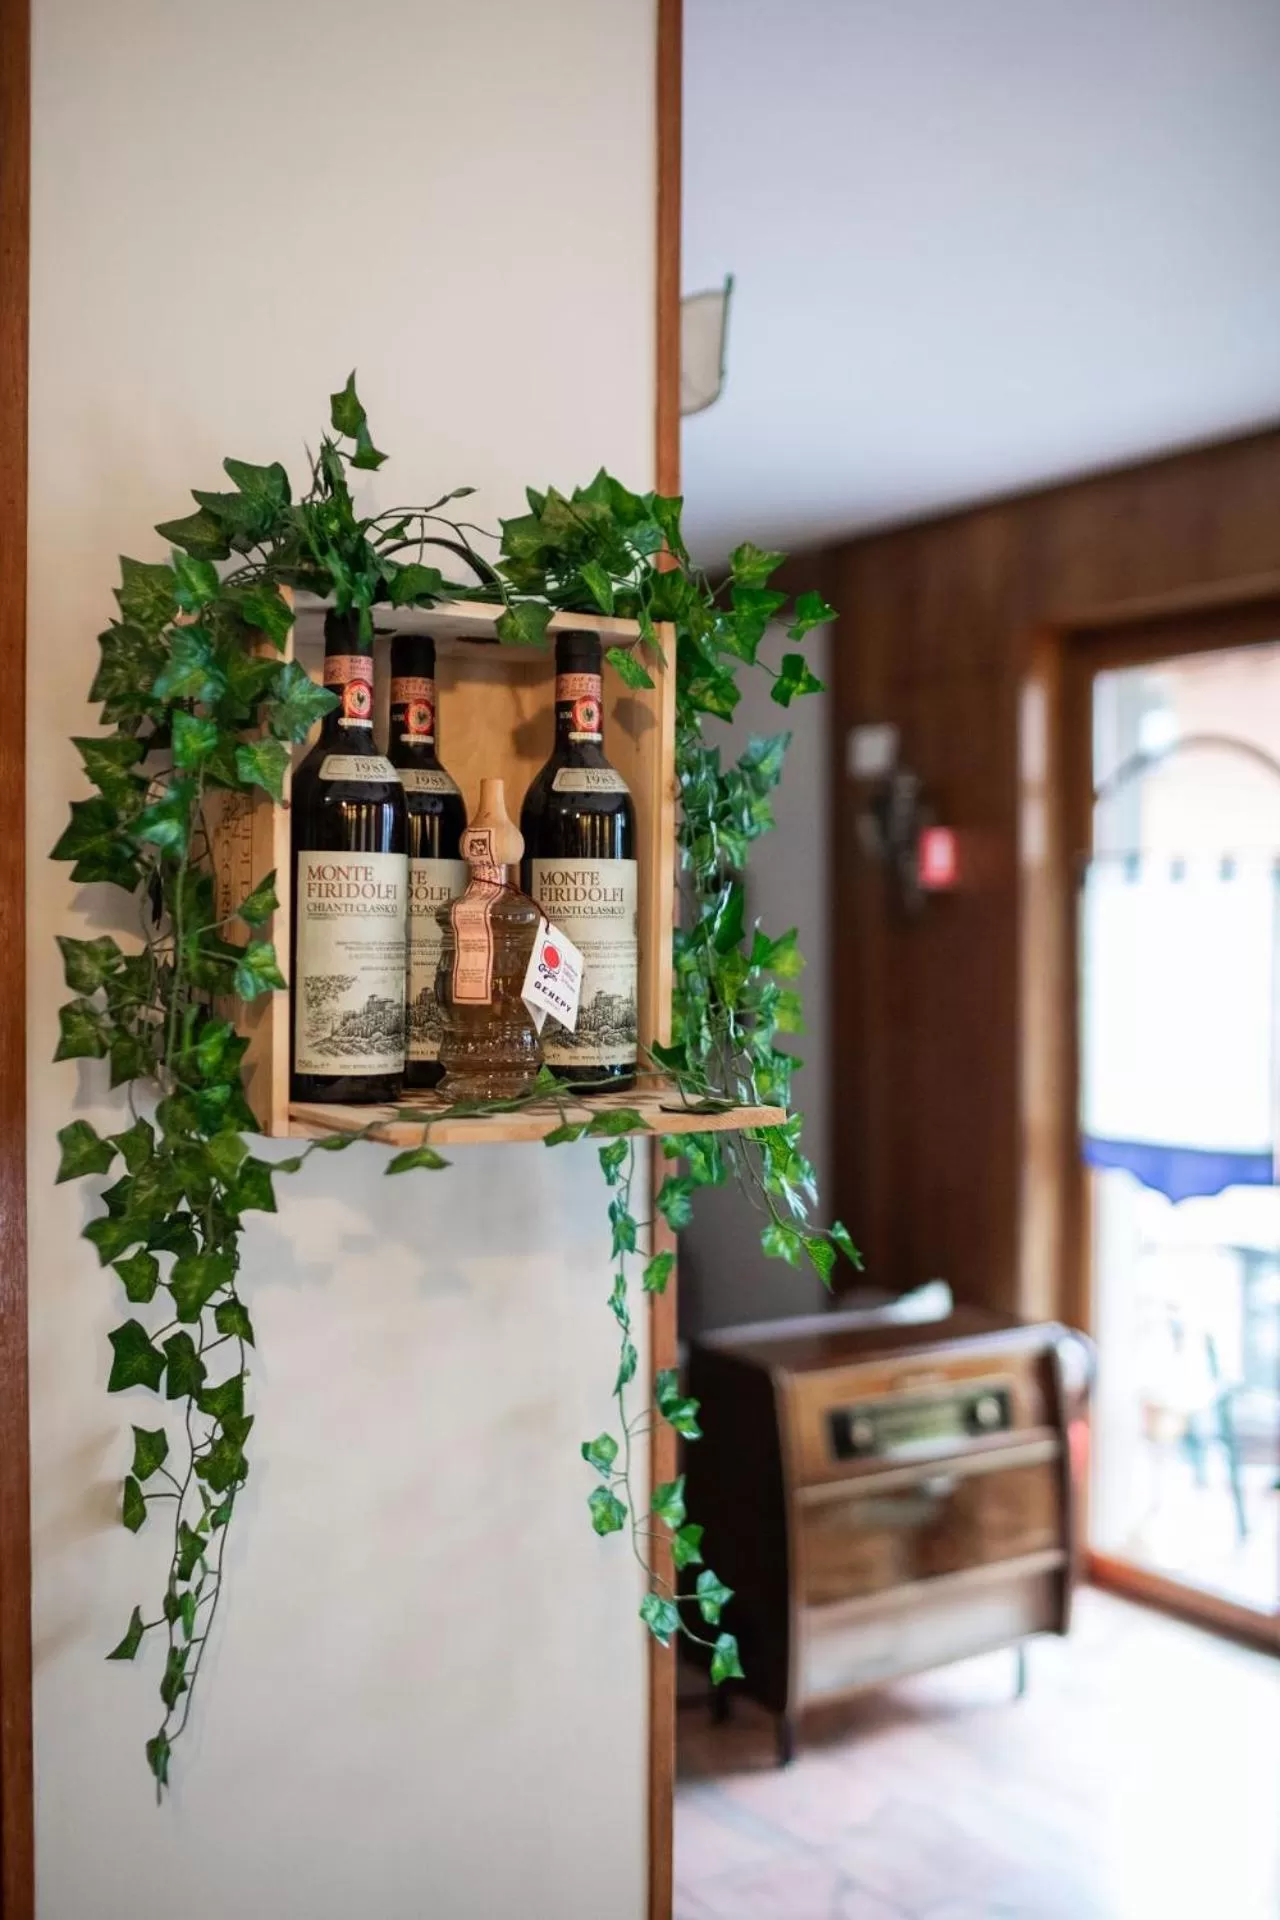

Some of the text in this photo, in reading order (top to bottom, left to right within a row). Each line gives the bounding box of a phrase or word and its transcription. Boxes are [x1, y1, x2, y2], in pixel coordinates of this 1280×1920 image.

[306, 864, 374, 881] MONTE
[539, 871, 600, 886] MONTE
[306, 882, 398, 900] FIRIDOLFI
[539, 887, 624, 903] FIRIDOLFI
[306, 902, 398, 914] CHIANTI CLASSICO
[583, 905, 625, 915] CLASSICO
